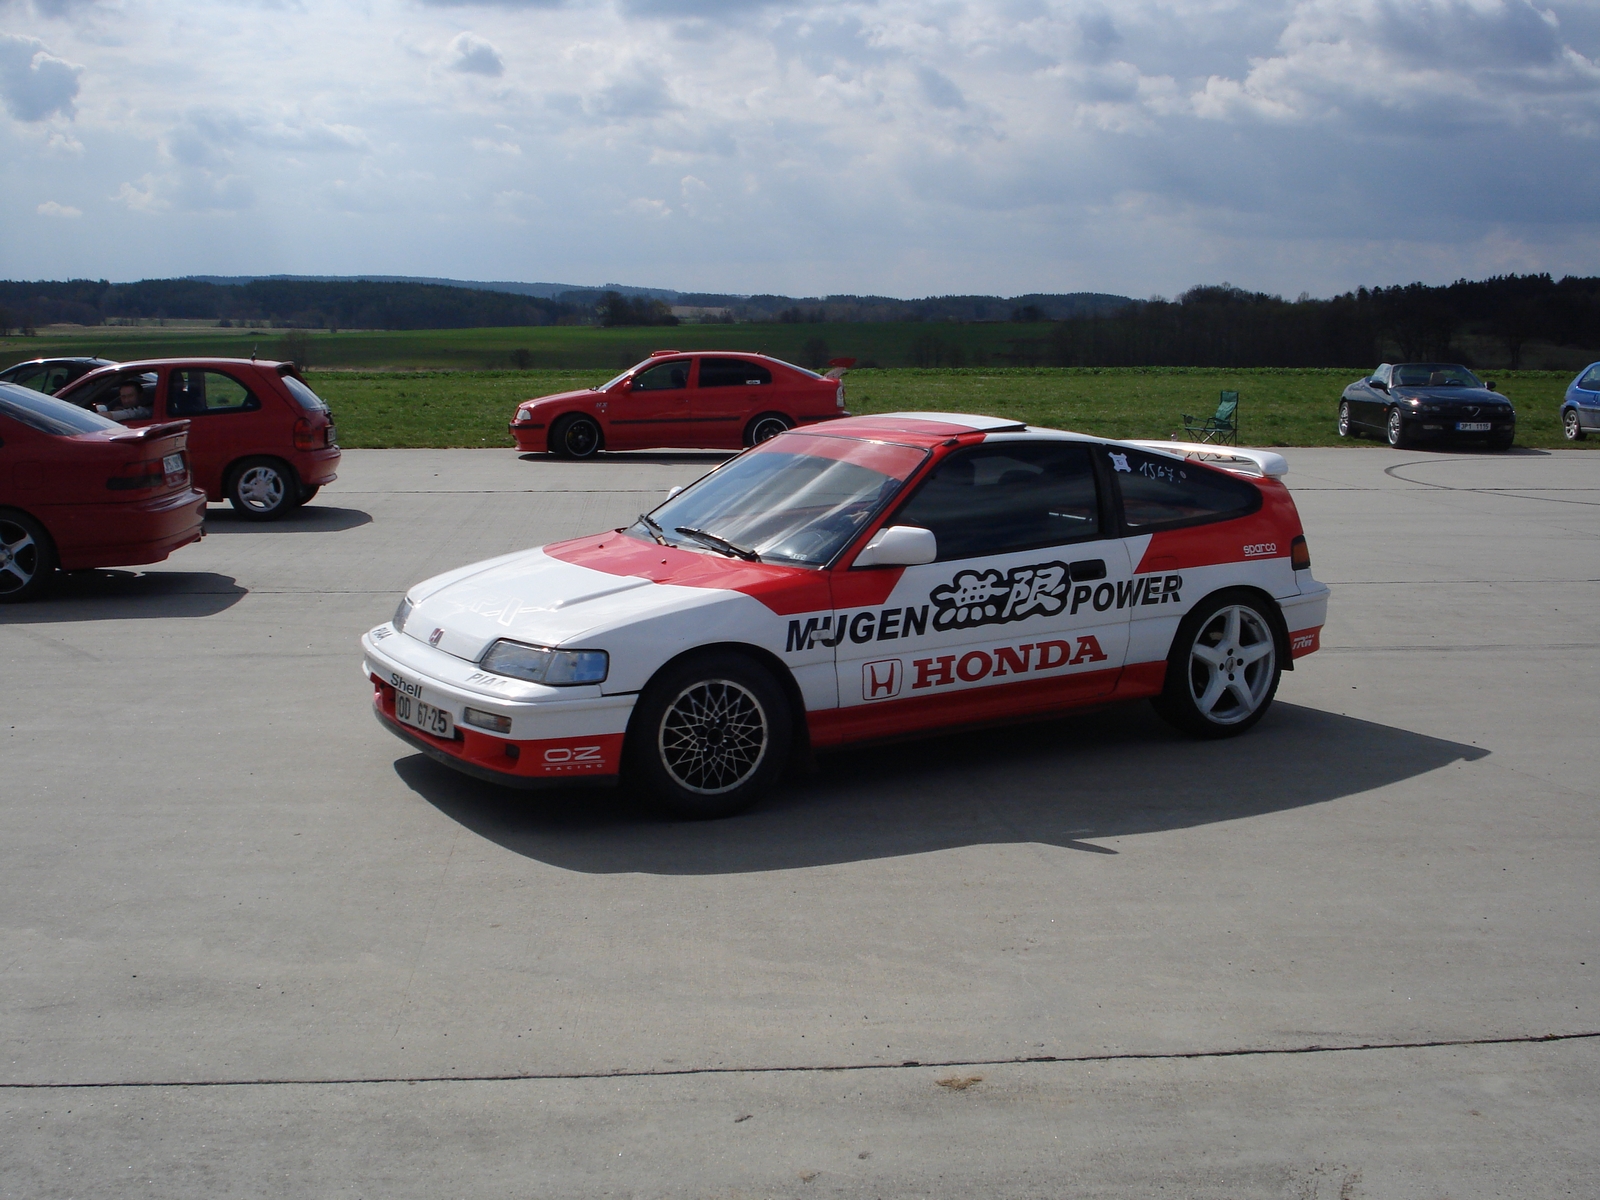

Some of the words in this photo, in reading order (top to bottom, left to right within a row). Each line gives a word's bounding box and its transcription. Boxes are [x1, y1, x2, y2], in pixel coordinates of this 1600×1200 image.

[1243, 543, 1277, 556] sparco
[785, 604, 930, 653] MUGEN
[1070, 574, 1184, 615] POWER
[911, 634, 1108, 690] HONDA
[390, 672, 423, 699] Shell
[545, 763, 603, 772] RACING
